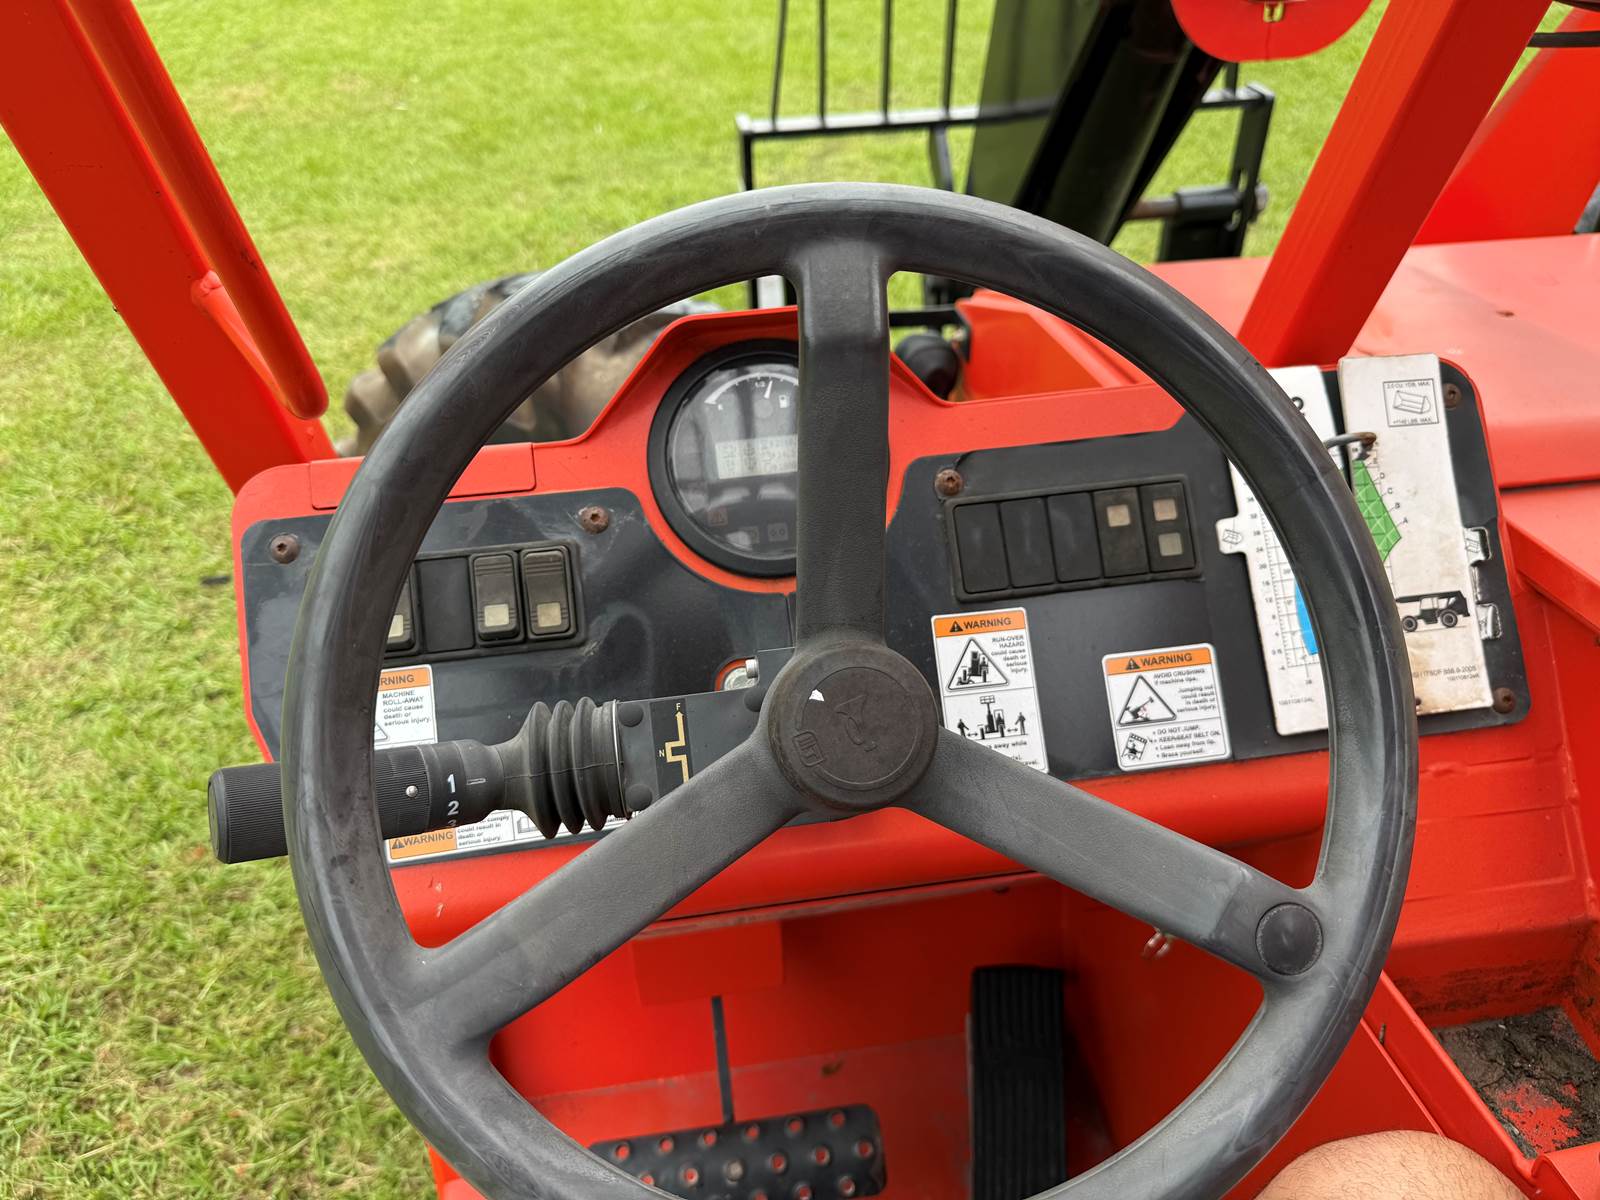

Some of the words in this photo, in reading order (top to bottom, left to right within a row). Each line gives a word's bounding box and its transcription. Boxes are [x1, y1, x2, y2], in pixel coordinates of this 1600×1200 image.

[963, 617, 1012, 630] WARNING
[992, 634, 1024, 642] RUN-OVER
[1140, 653, 1193, 666] WARNING
[1173, 669, 1205, 677] CRUSHING
[380, 674, 415, 686] RNING
[382, 690, 416, 699] MACHINE
[382, 696, 424, 706] ROLL-AWAY
[675, 702, 681, 710] F
[659, 750, 665, 758] N
[447, 774, 456, 794] 1
[447, 801, 460, 815] 2
[457, 826, 475, 834] could
[404, 831, 454, 846] WARNING
